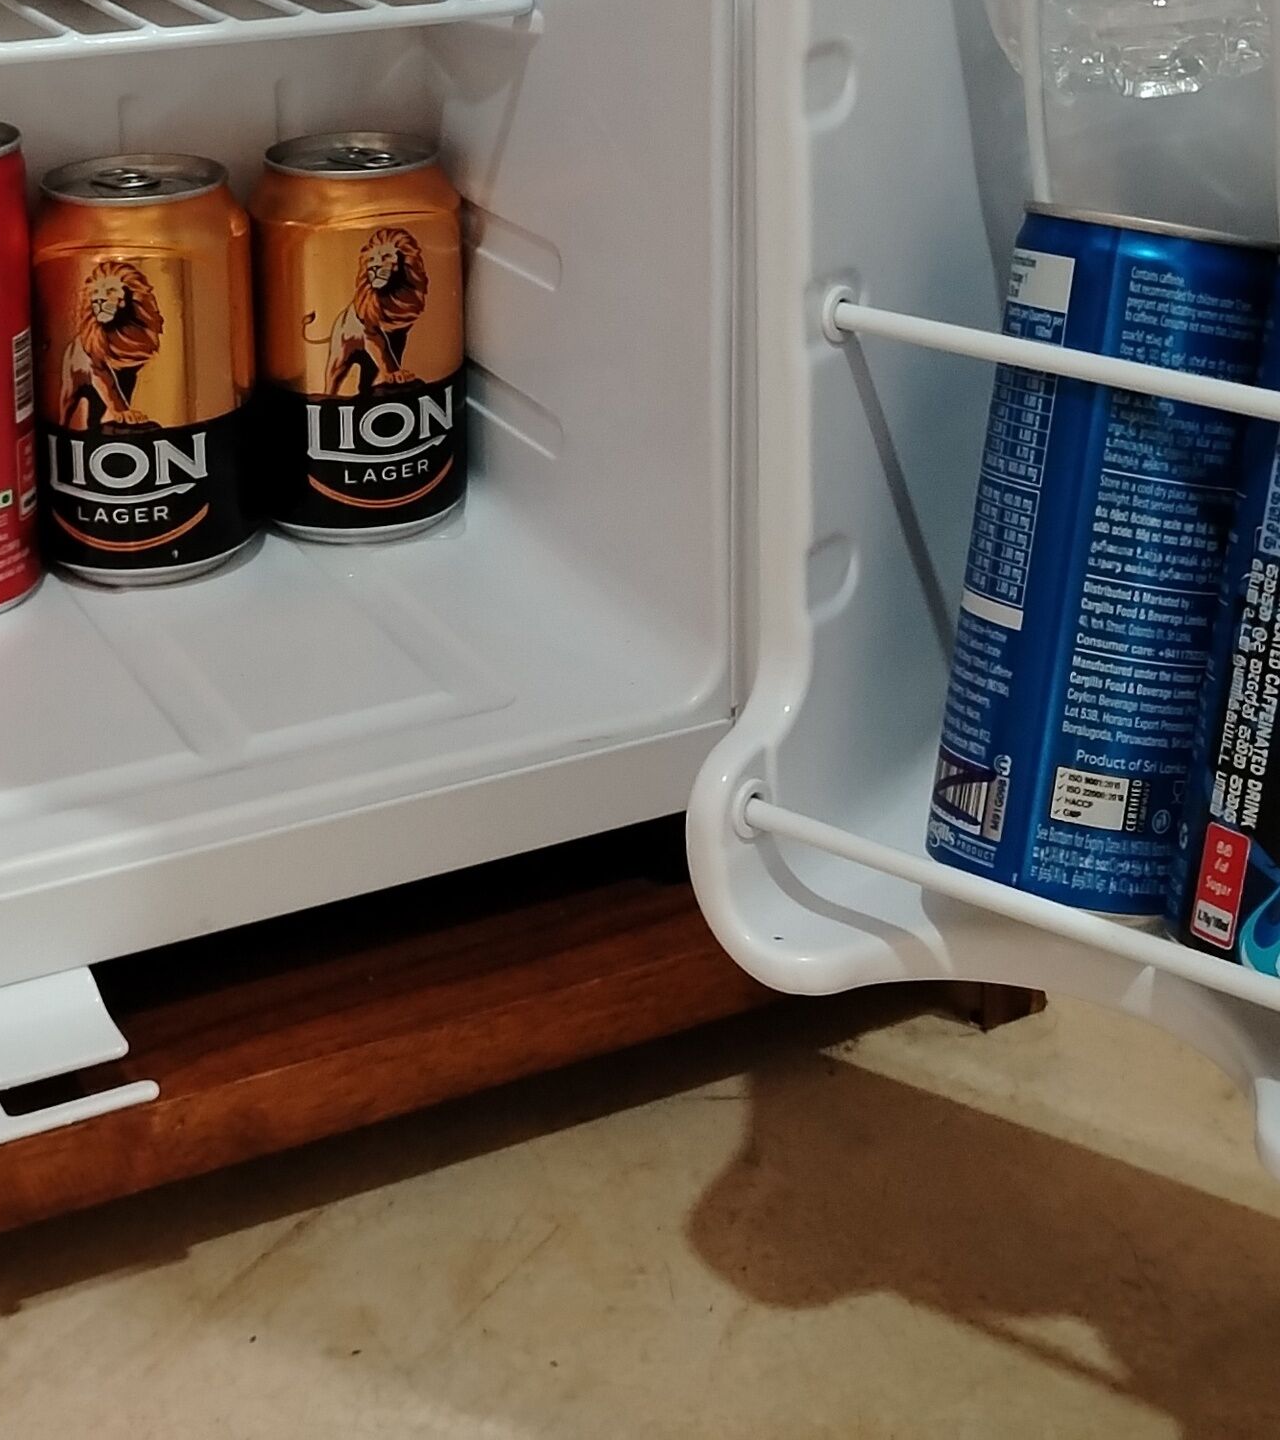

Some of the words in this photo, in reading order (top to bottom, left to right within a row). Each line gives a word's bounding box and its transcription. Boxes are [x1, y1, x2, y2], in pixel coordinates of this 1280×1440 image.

[306, 386, 455, 463] LION
[48, 431, 208, 504] LION
[343, 457, 431, 485] LAGER
[77, 504, 171, 525] LAGER
[1076, 631, 1130, 654] Consumer
[1075, 748, 1127, 770] Product
[1124, 778, 1144, 833] CERTIFIED
[1239, 777, 1264, 831] DRINK
[1205, 874, 1233, 897] Sugar
